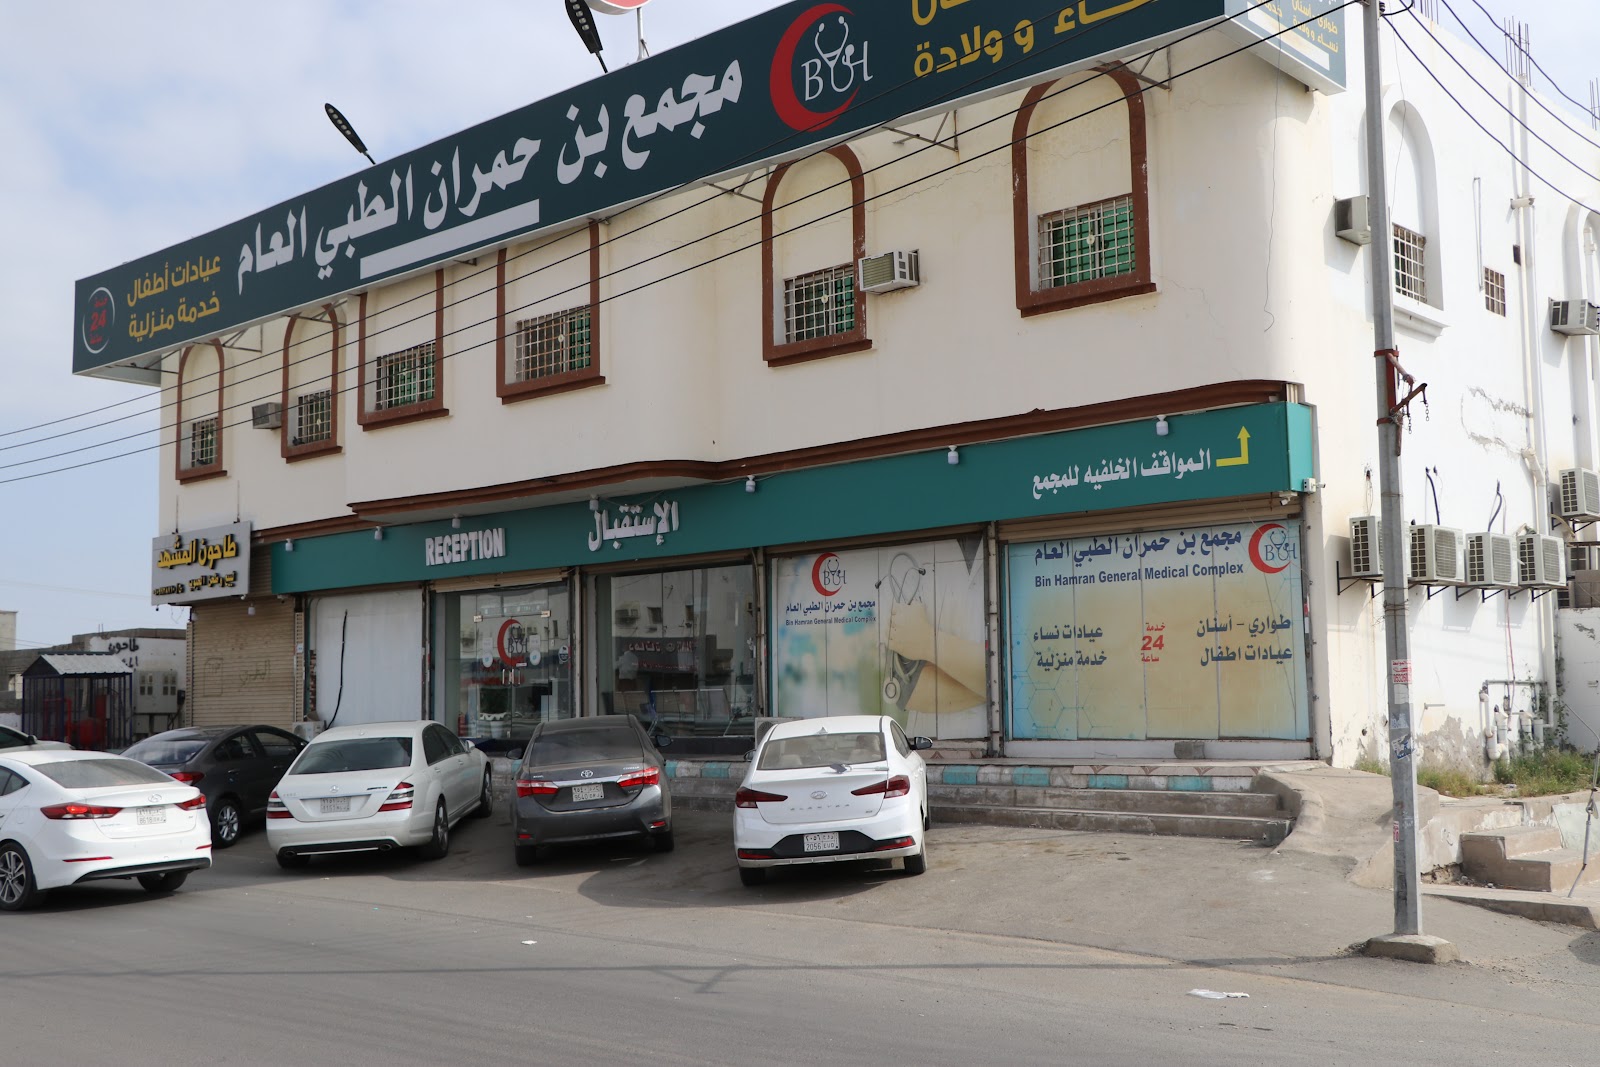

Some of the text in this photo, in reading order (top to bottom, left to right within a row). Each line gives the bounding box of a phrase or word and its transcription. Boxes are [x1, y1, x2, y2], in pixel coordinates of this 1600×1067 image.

[1013, 19, 1034, 54] و
[914, 25, 1003, 78] ولادة
[238, 59, 742, 295] مجمع بن حمران الطبي العام
[127, 256, 221, 307] عيادات أطفال
[90, 309, 107, 332] 24
[128, 291, 220, 343] خدمة منزلية
[1032, 447, 1211, 500] المواقف الخلفيه للمجمع
[588, 500, 680, 552] الإستقبال
[198, 533, 238, 570] طاحون
[425, 528, 506, 566] RECEPTION
[1034, 529, 1242, 568] مجمع بن حمران الطبي العام
[1034, 561, 1244, 588] Bin Hamran General Medical Complex
[785, 599, 876, 616] مجمع بن حمران الطبي العام
[833, 616, 854, 624] Medical
[1145, 622, 1166, 632] خدمة
[1196, 615, 1232, 638] أسنان
[1248, 614, 1291, 638] طواري
[1033, 624, 1103, 643] عيادات نساء
[1140, 635, 1165, 651] 24
[1036, 650, 1107, 671] خدمة منزلية
[1140, 653, 1160, 663] ساعة
[1245, 644, 1293, 665] عيادات
[806, 842, 822, 851] 2056
